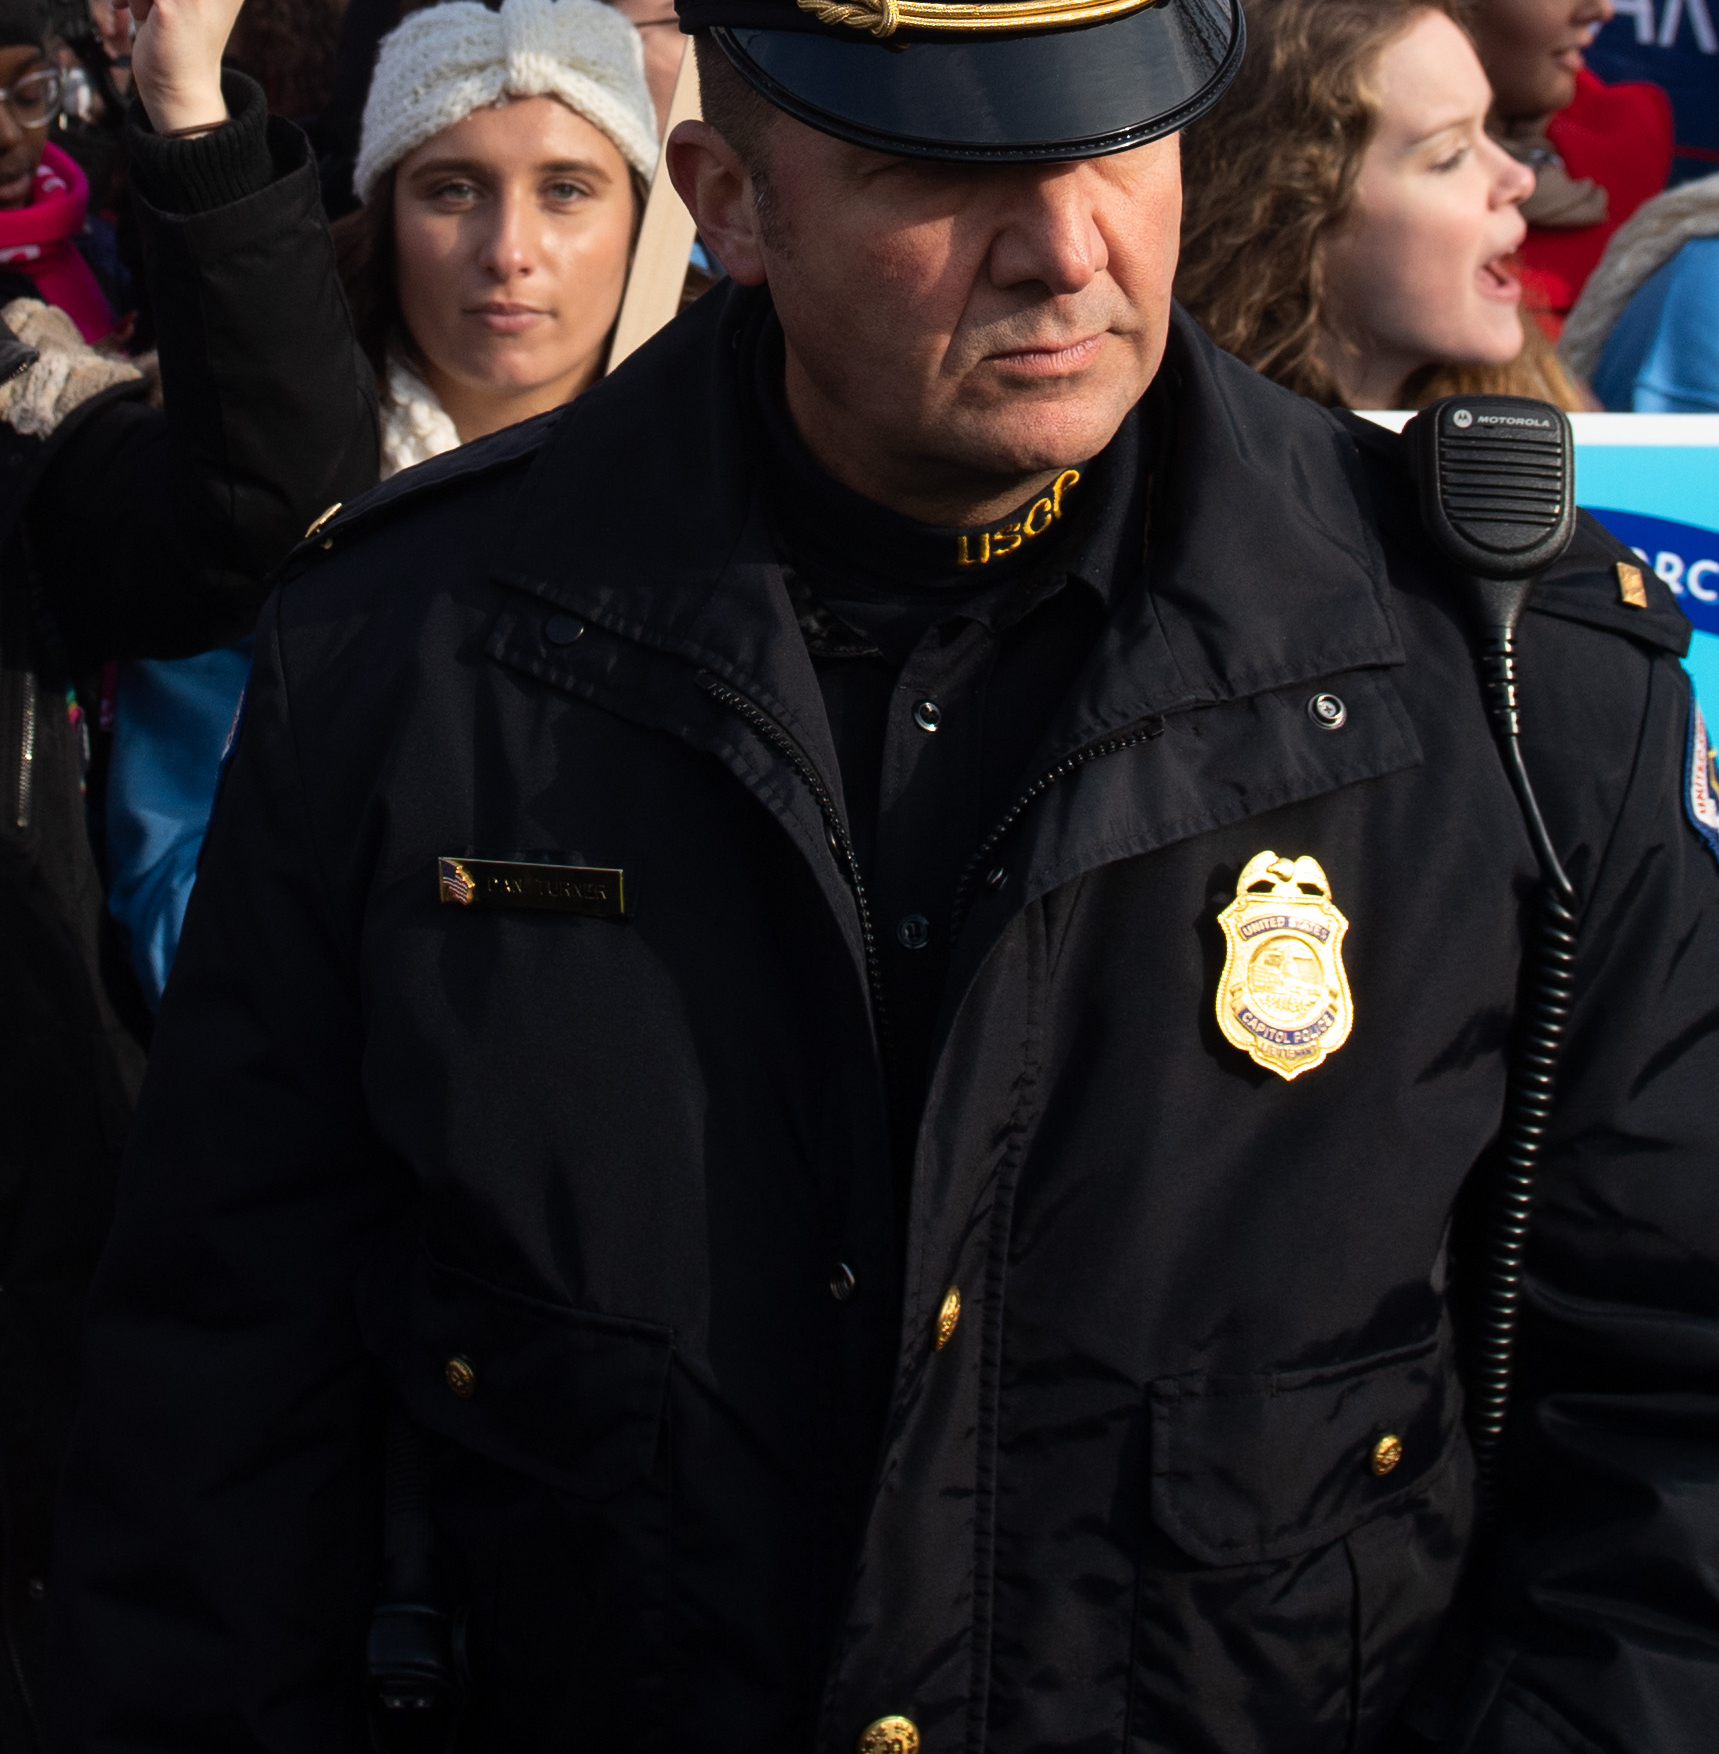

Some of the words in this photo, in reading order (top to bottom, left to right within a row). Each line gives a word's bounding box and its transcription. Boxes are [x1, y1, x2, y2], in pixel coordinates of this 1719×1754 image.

[1477, 415, 1551, 428] MOTOROLA
[957, 469, 1080, 566] USCP
[1242, 916, 1285, 937] UNITED
[1241, 1011, 1290, 1044] CAPITOL
[1294, 1013, 1335, 1043] POLICE
